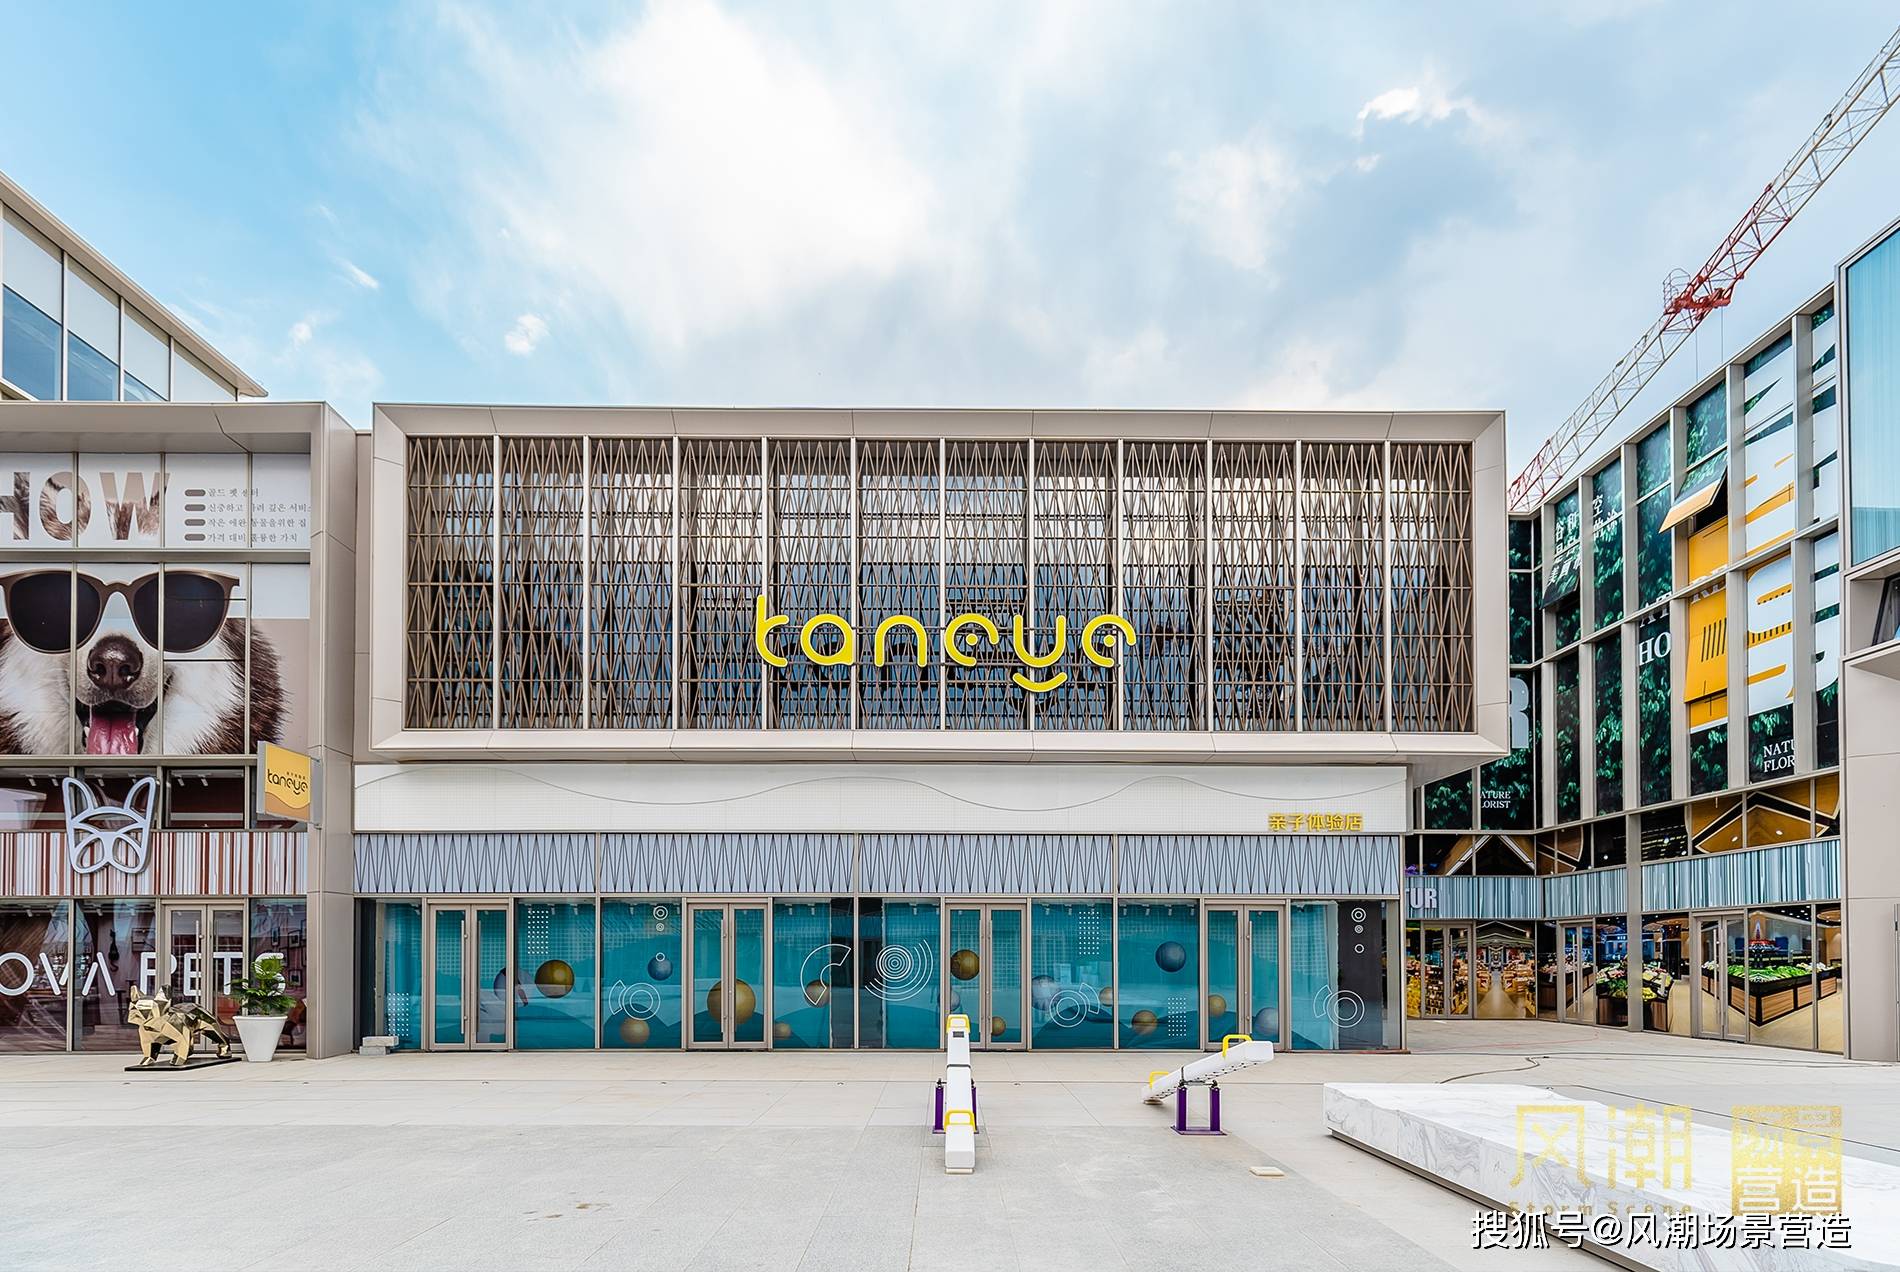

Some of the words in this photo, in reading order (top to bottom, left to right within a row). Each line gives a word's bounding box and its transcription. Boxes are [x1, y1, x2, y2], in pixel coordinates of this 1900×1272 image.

[1481, 800, 1511, 809] ORIST
[1268, 812, 1363, 832] 亲子体验店
